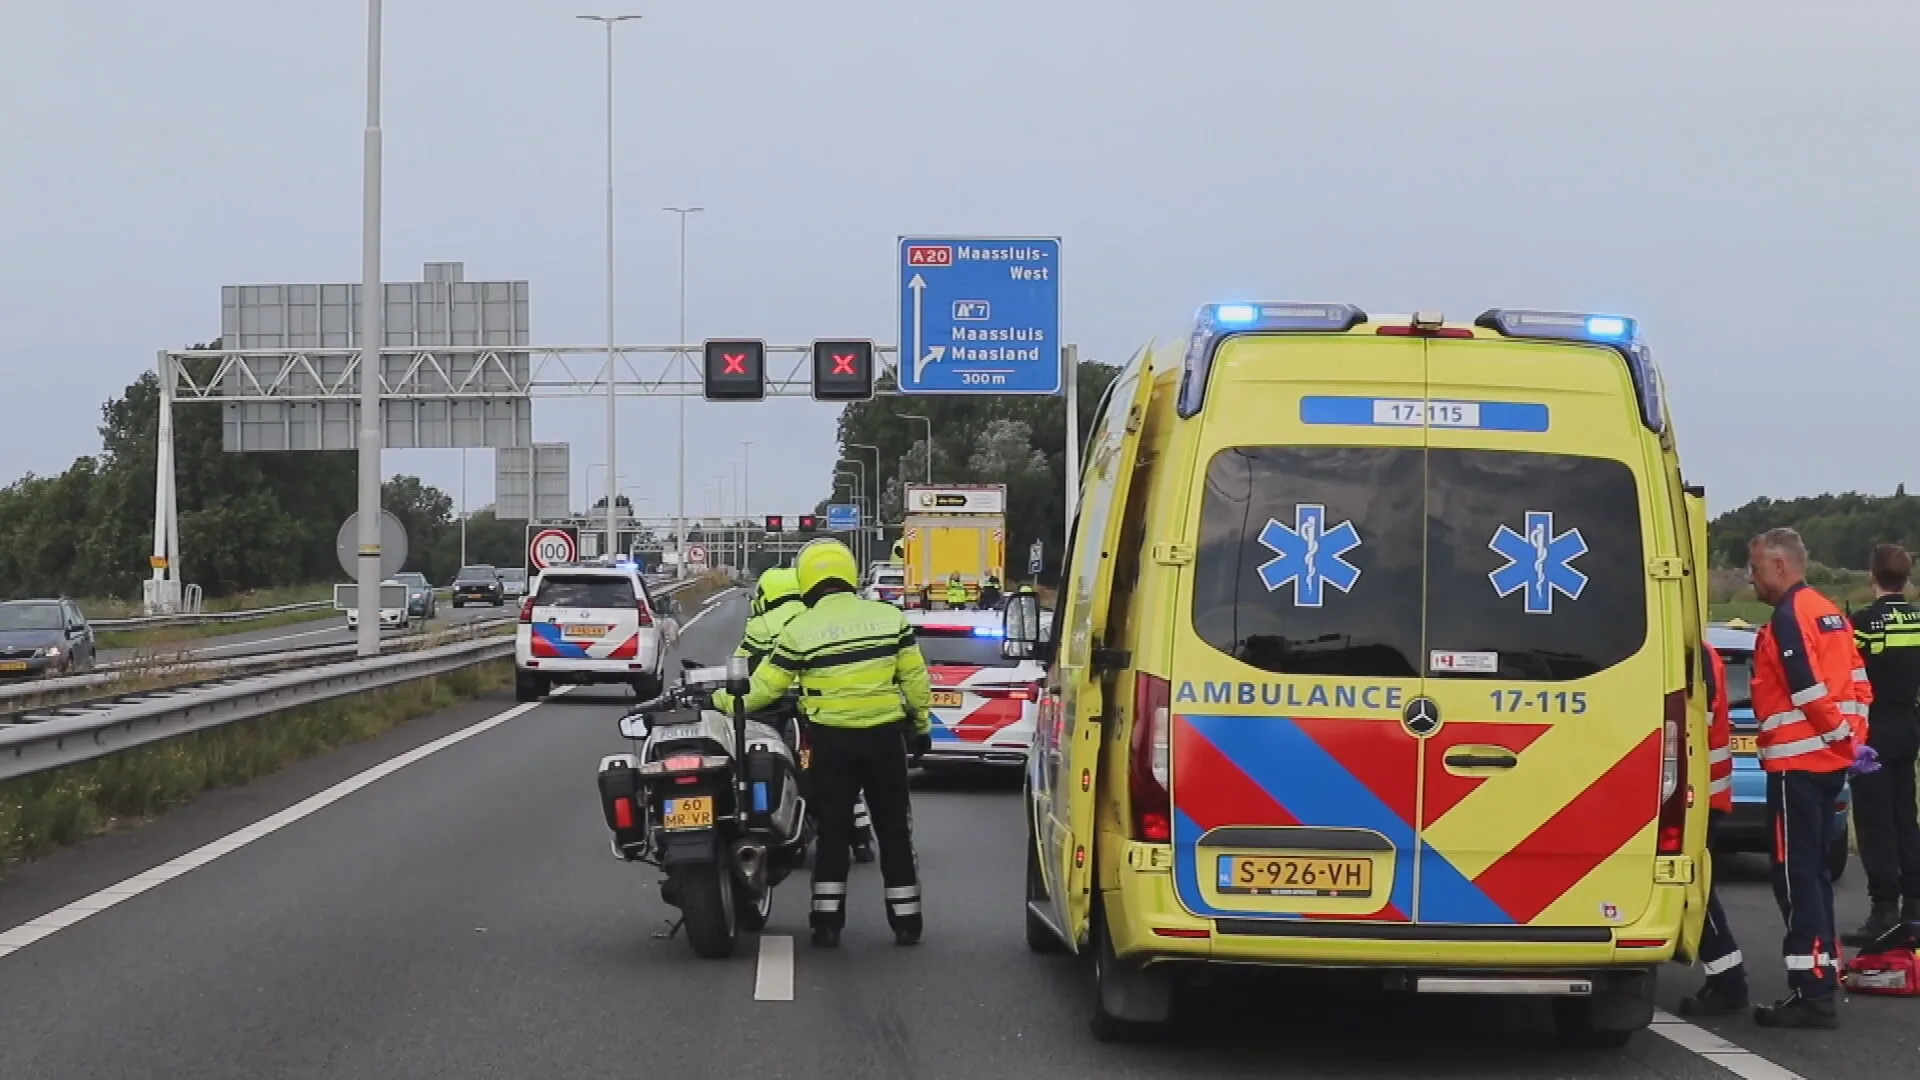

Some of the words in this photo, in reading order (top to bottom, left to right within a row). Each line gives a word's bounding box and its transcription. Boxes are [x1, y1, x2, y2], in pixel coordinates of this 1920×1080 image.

[912, 249, 947, 263] A20
[957, 245, 1049, 260] Maassluis-
[1009, 265, 1049, 281] West
[976, 304, 986, 317] 7
[951, 326, 1044, 341] Maassluis
[951, 346, 1039, 361] Maasland
[1391, 403, 1463, 423] 17-115
[540, 543, 566, 560] 100
[1175, 680, 1403, 709] AMBULANCE
[1489, 689, 1588, 715] 17-115
[682, 799, 702, 811] 60
[1240, 860, 1362, 887] S-926-VH
